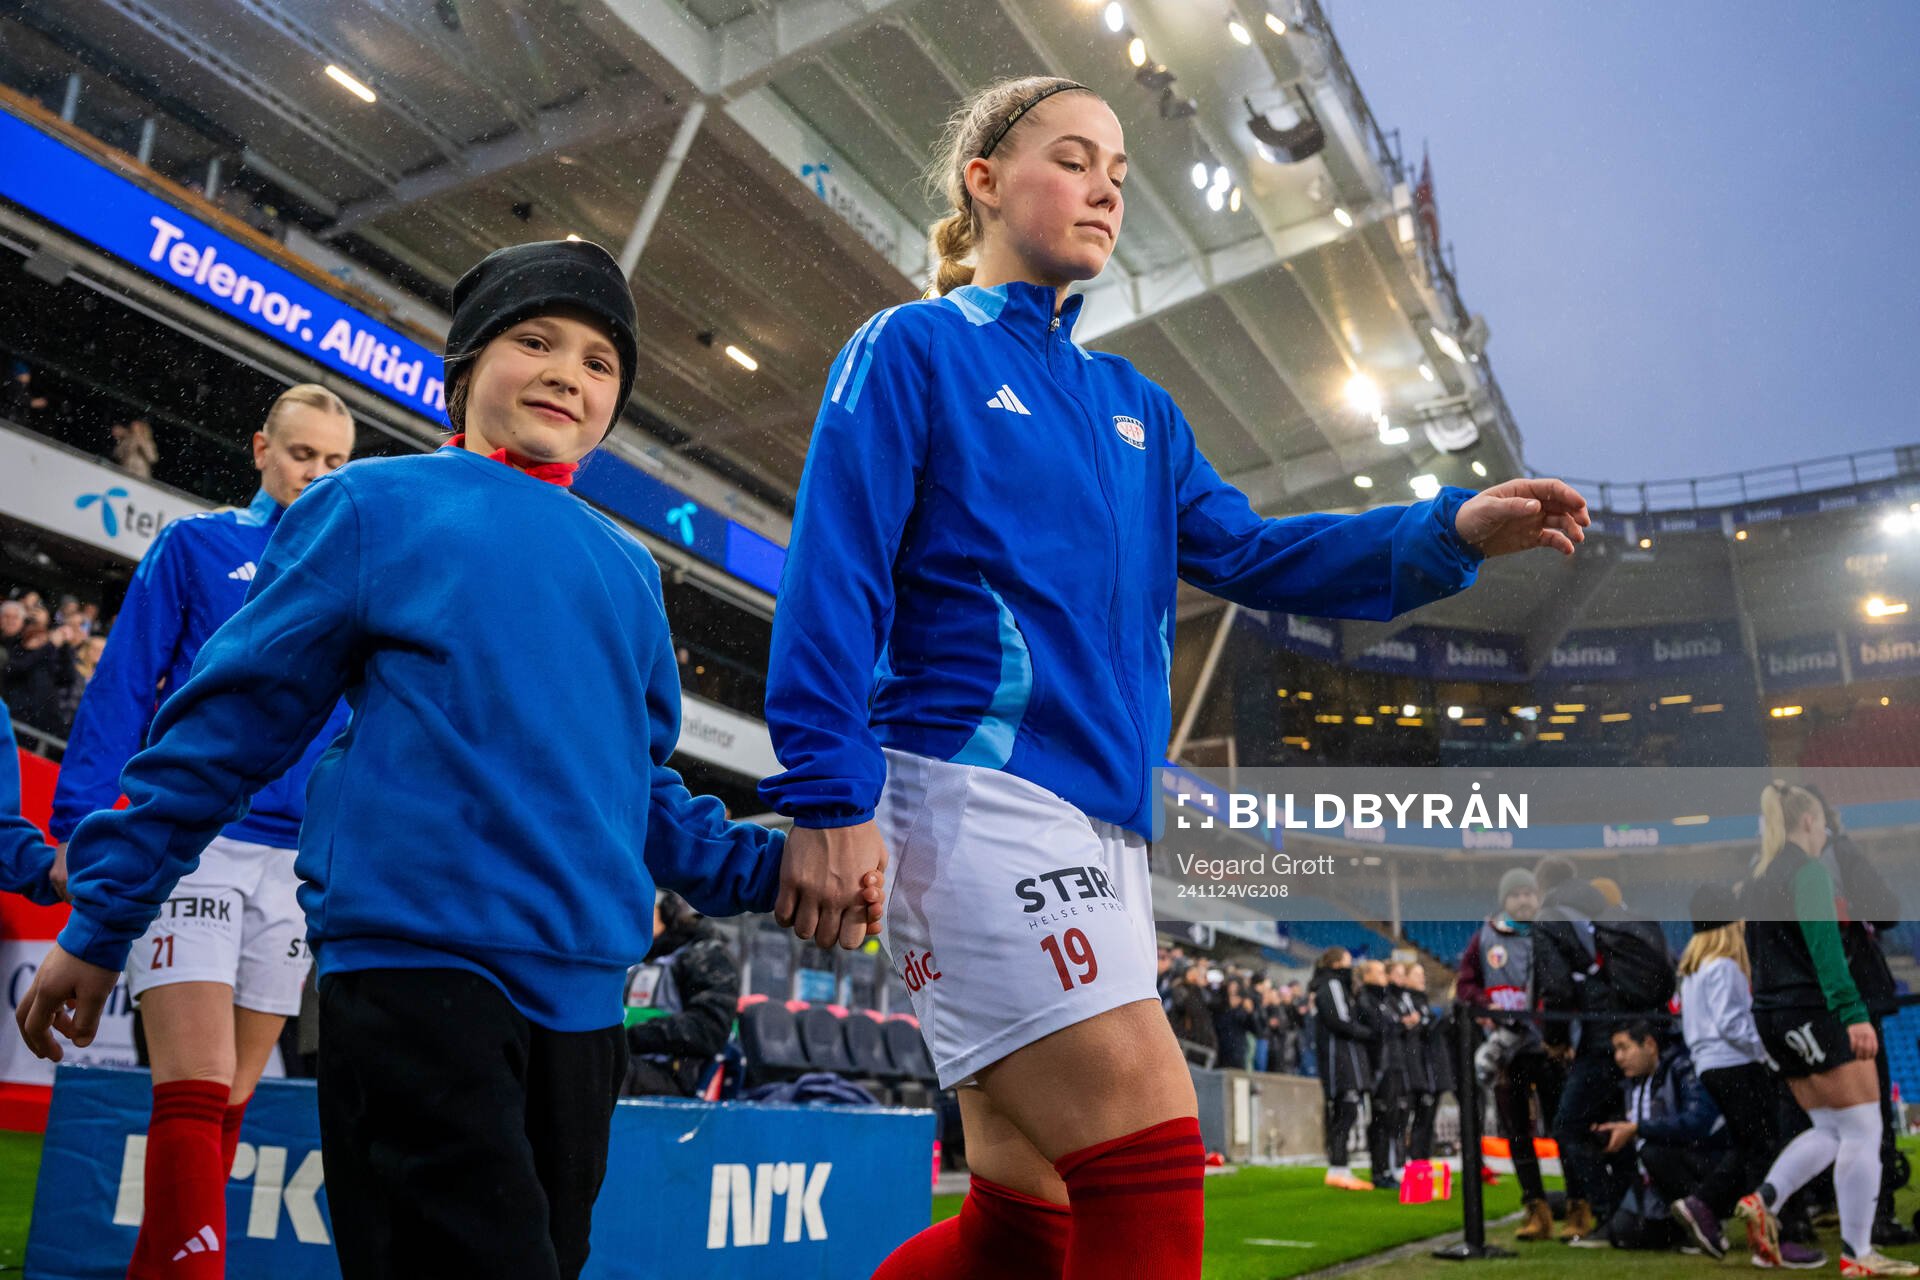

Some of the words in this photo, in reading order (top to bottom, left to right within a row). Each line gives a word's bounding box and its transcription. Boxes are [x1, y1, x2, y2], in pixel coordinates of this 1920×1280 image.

[1008, 106, 1023, 122] NIKE
[150, 215, 314, 342] Telenor.
[319, 318, 424, 397] Alltid
[124, 502, 164, 538] tel
[160, 897, 230, 922] TERK
[1028, 907, 1078, 930] HELSE
[1086, 904, 1094, 913] &
[151, 935, 174, 970] 21
[1040, 927, 1098, 992] 19
[903, 950, 942, 997] dic
[706, 1161, 833, 1249] NRK
